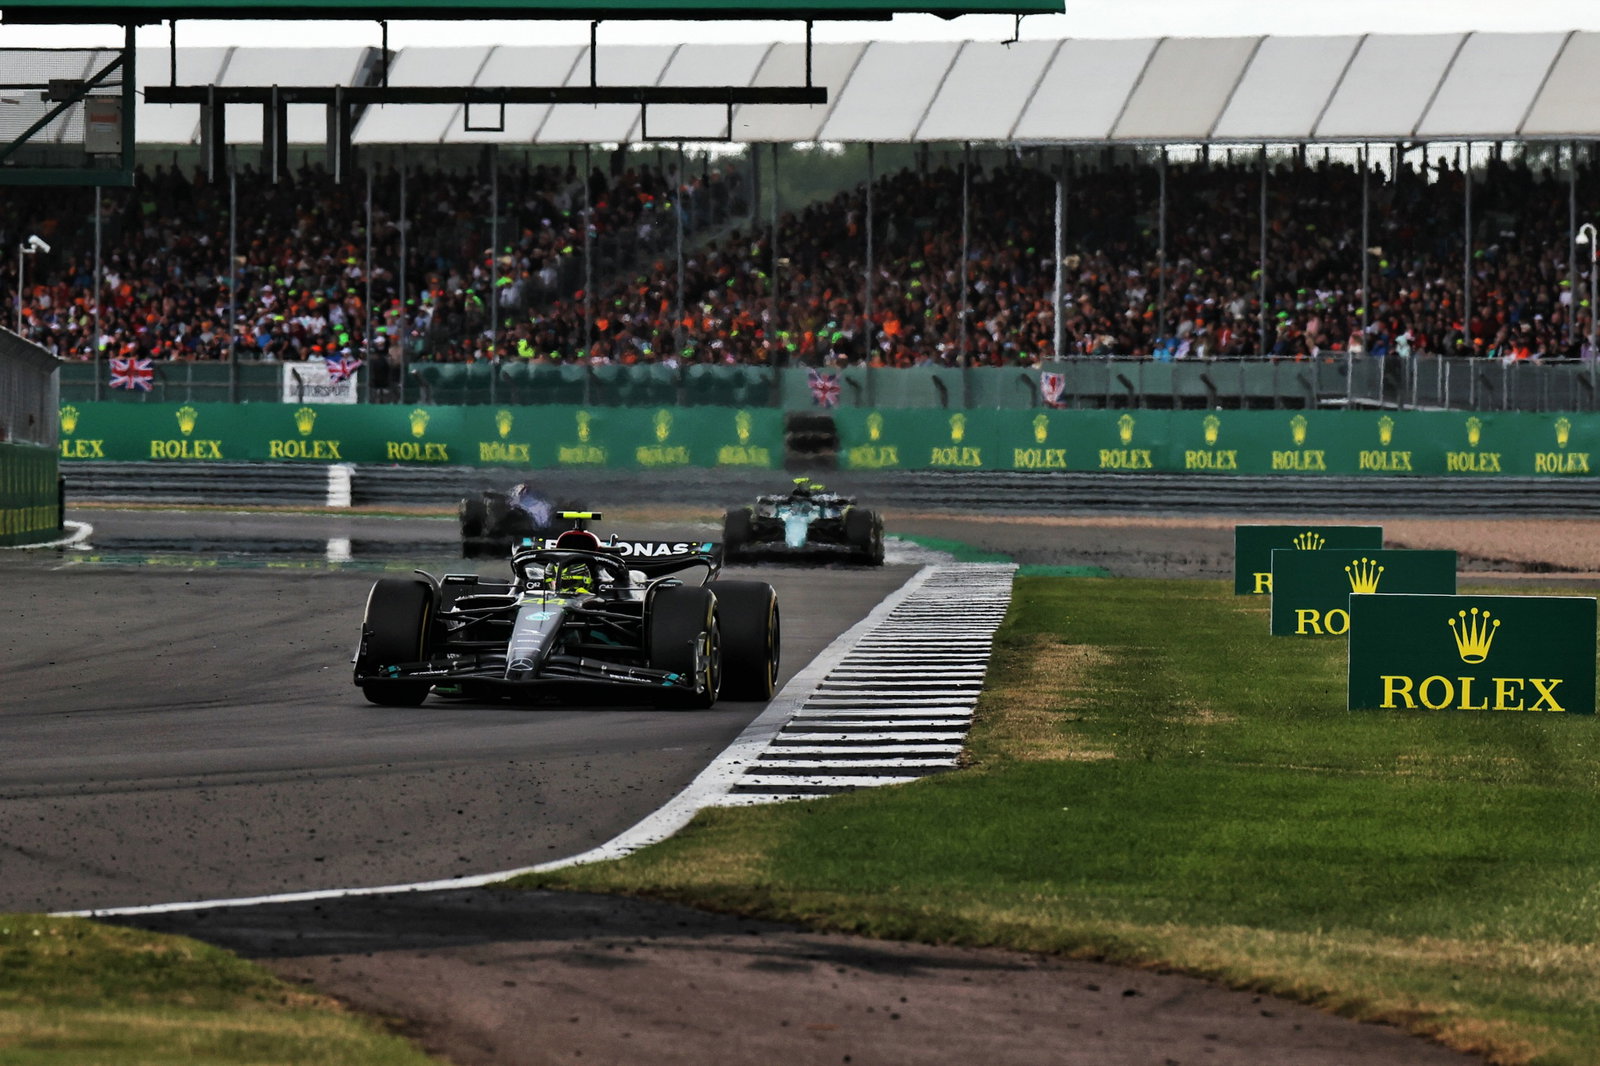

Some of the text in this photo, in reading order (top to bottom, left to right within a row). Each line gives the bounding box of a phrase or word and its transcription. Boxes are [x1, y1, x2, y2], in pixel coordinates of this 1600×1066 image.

[60, 439, 104, 458] LEX
[150, 439, 222, 459] ROLEX
[269, 439, 341, 460] ROLEX
[386, 442, 448, 461] ROLEX
[931, 447, 982, 467] ROLEX
[1014, 449, 1067, 468] ROLEX
[1099, 449, 1153, 469] ROLEX
[1184, 450, 1237, 469] ROLEX
[1272, 450, 1326, 470] ROLEX
[1359, 451, 1412, 471] ROLEX
[1447, 452, 1501, 472] ROLEX
[1535, 453, 1590, 473] ROLEX
[545, 539, 689, 556] PONAS
[1380, 675, 1565, 711] ROLEX
